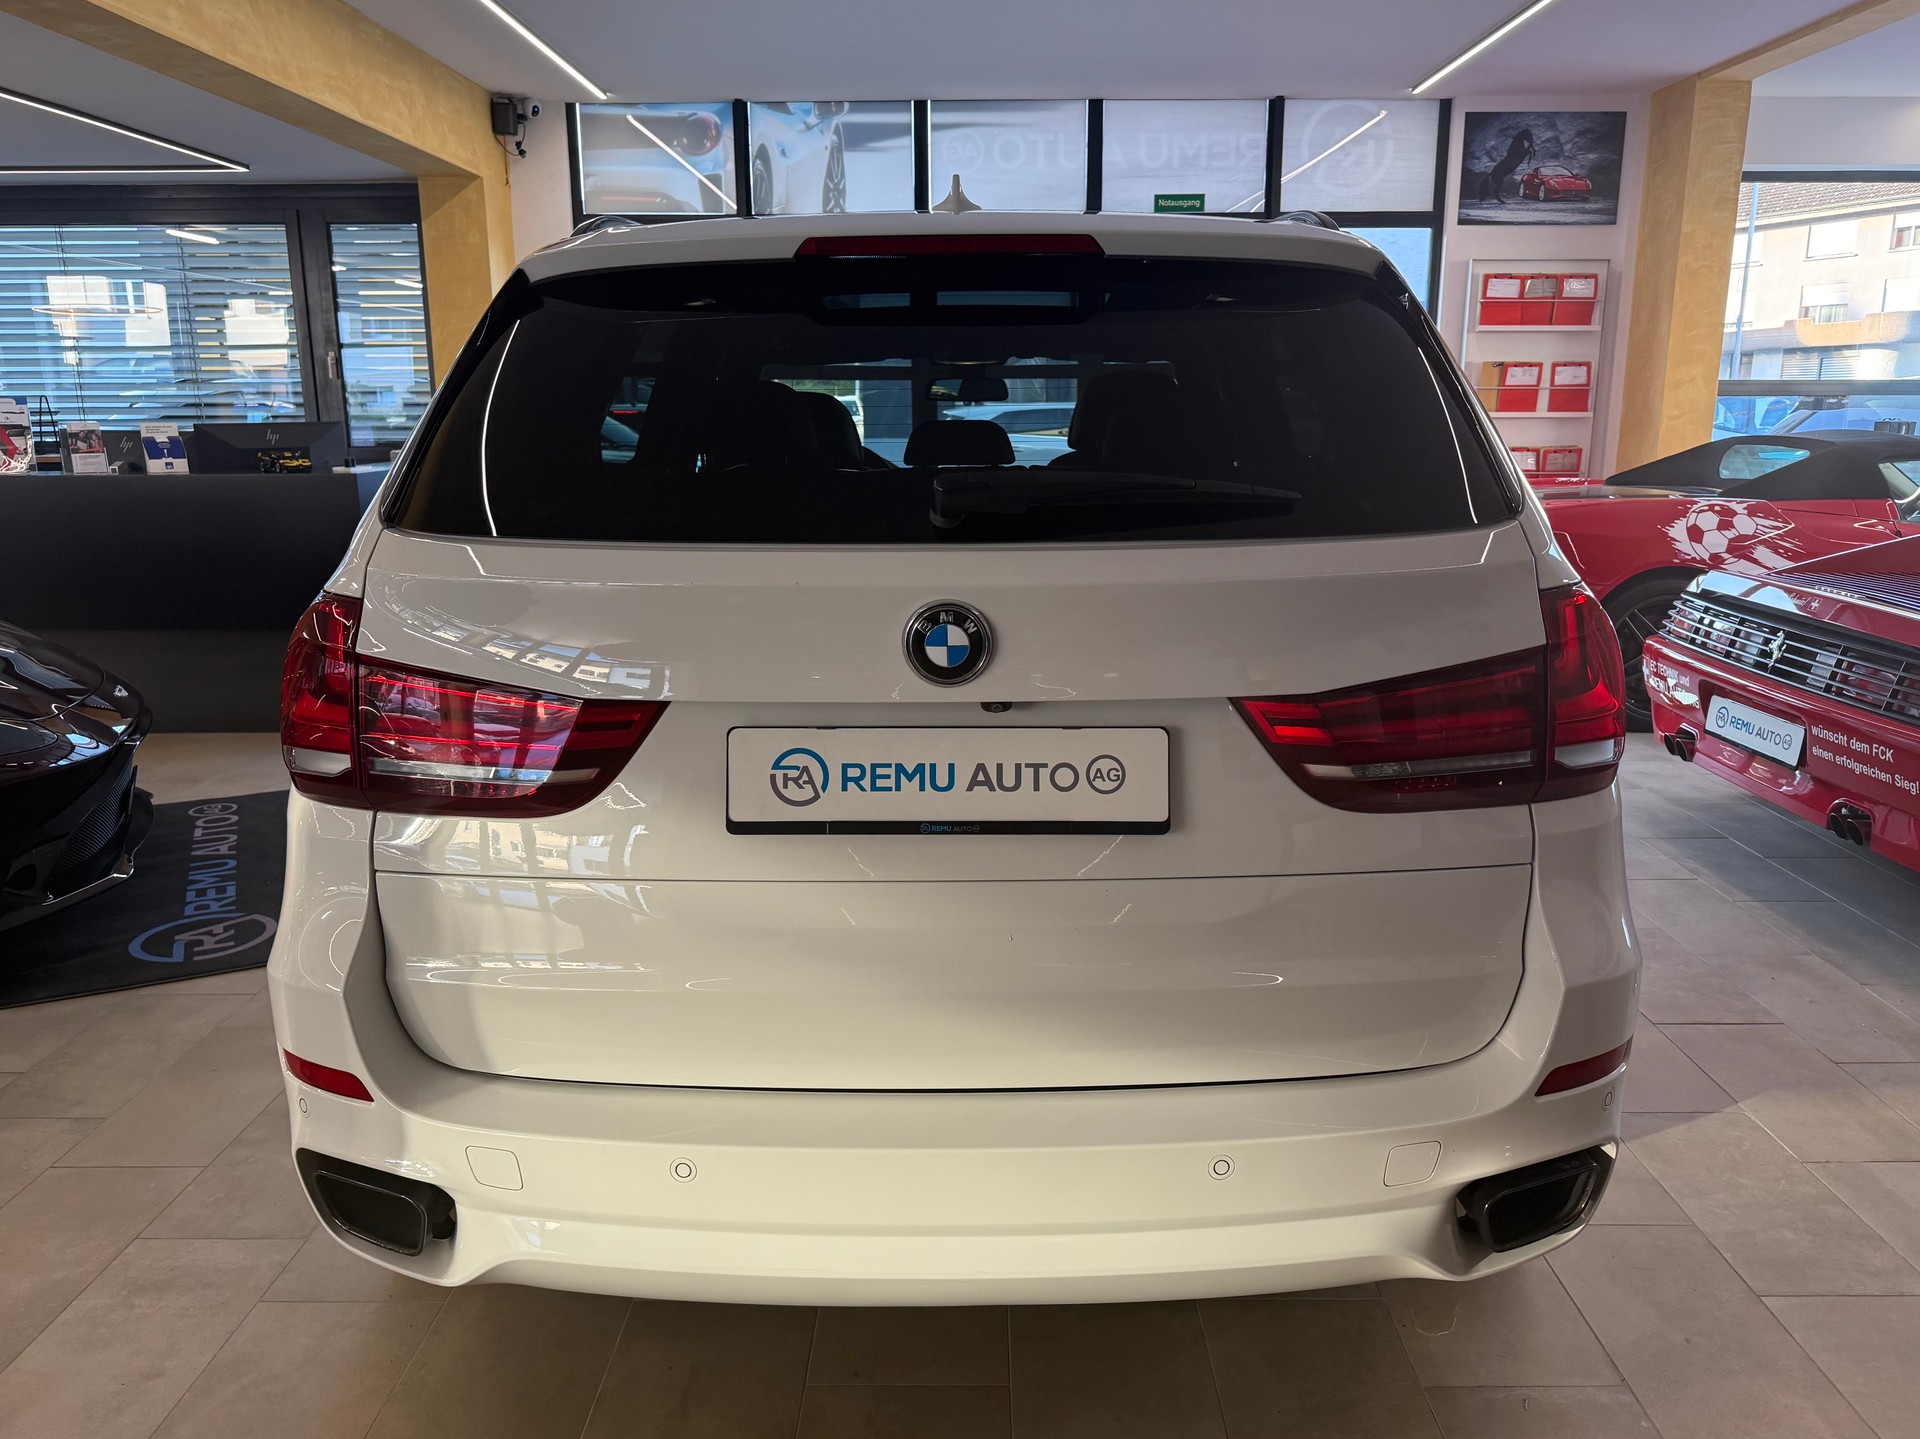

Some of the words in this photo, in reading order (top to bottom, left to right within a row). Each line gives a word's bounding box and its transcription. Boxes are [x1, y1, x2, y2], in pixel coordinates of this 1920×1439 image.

[1158, 199, 1200, 208] Notausgang
[917, 611, 978, 634] BMW
[1679, 675, 1690, 687] und
[1729, 715, 1756, 735] REMU
[1755, 726, 1782, 746] AUTO
[1811, 724, 1848, 747] wünscht
[1850, 737, 1870, 755] dem
[1872, 744, 1894, 763] FCK
[841, 763, 955, 792] REMU
[965, 762, 1080, 793] AUTO
[1812, 745, 1834, 762] einen
[1835, 755, 1892, 784] erfolgreichen
[1894, 774, 1920, 795] Sieg!
[190, 814, 239, 855] AUTO
[184, 858, 238, 916] REMU
